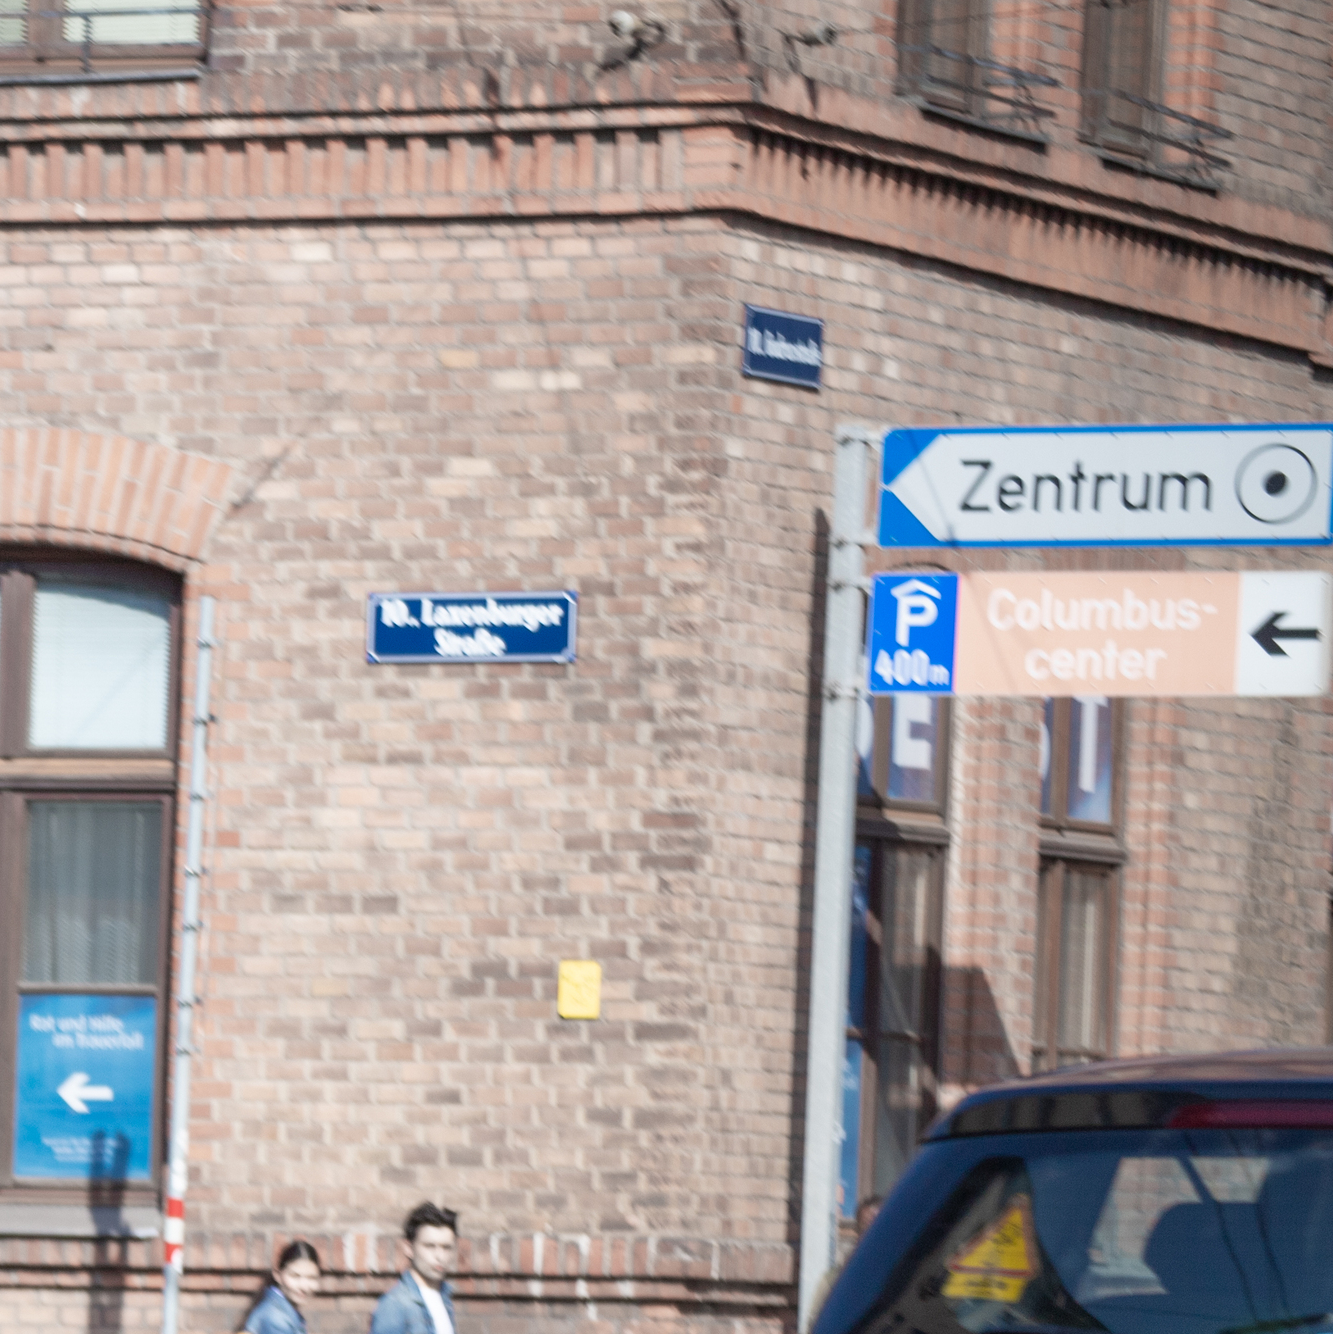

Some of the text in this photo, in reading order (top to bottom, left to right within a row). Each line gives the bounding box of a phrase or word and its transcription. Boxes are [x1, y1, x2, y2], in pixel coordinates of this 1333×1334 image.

[959, 459, 1214, 513] Zentrum
[895, 594, 939, 648] P
[986, 588, 1219, 632] Columbus-
[1024, 639, 1168, 681] center
